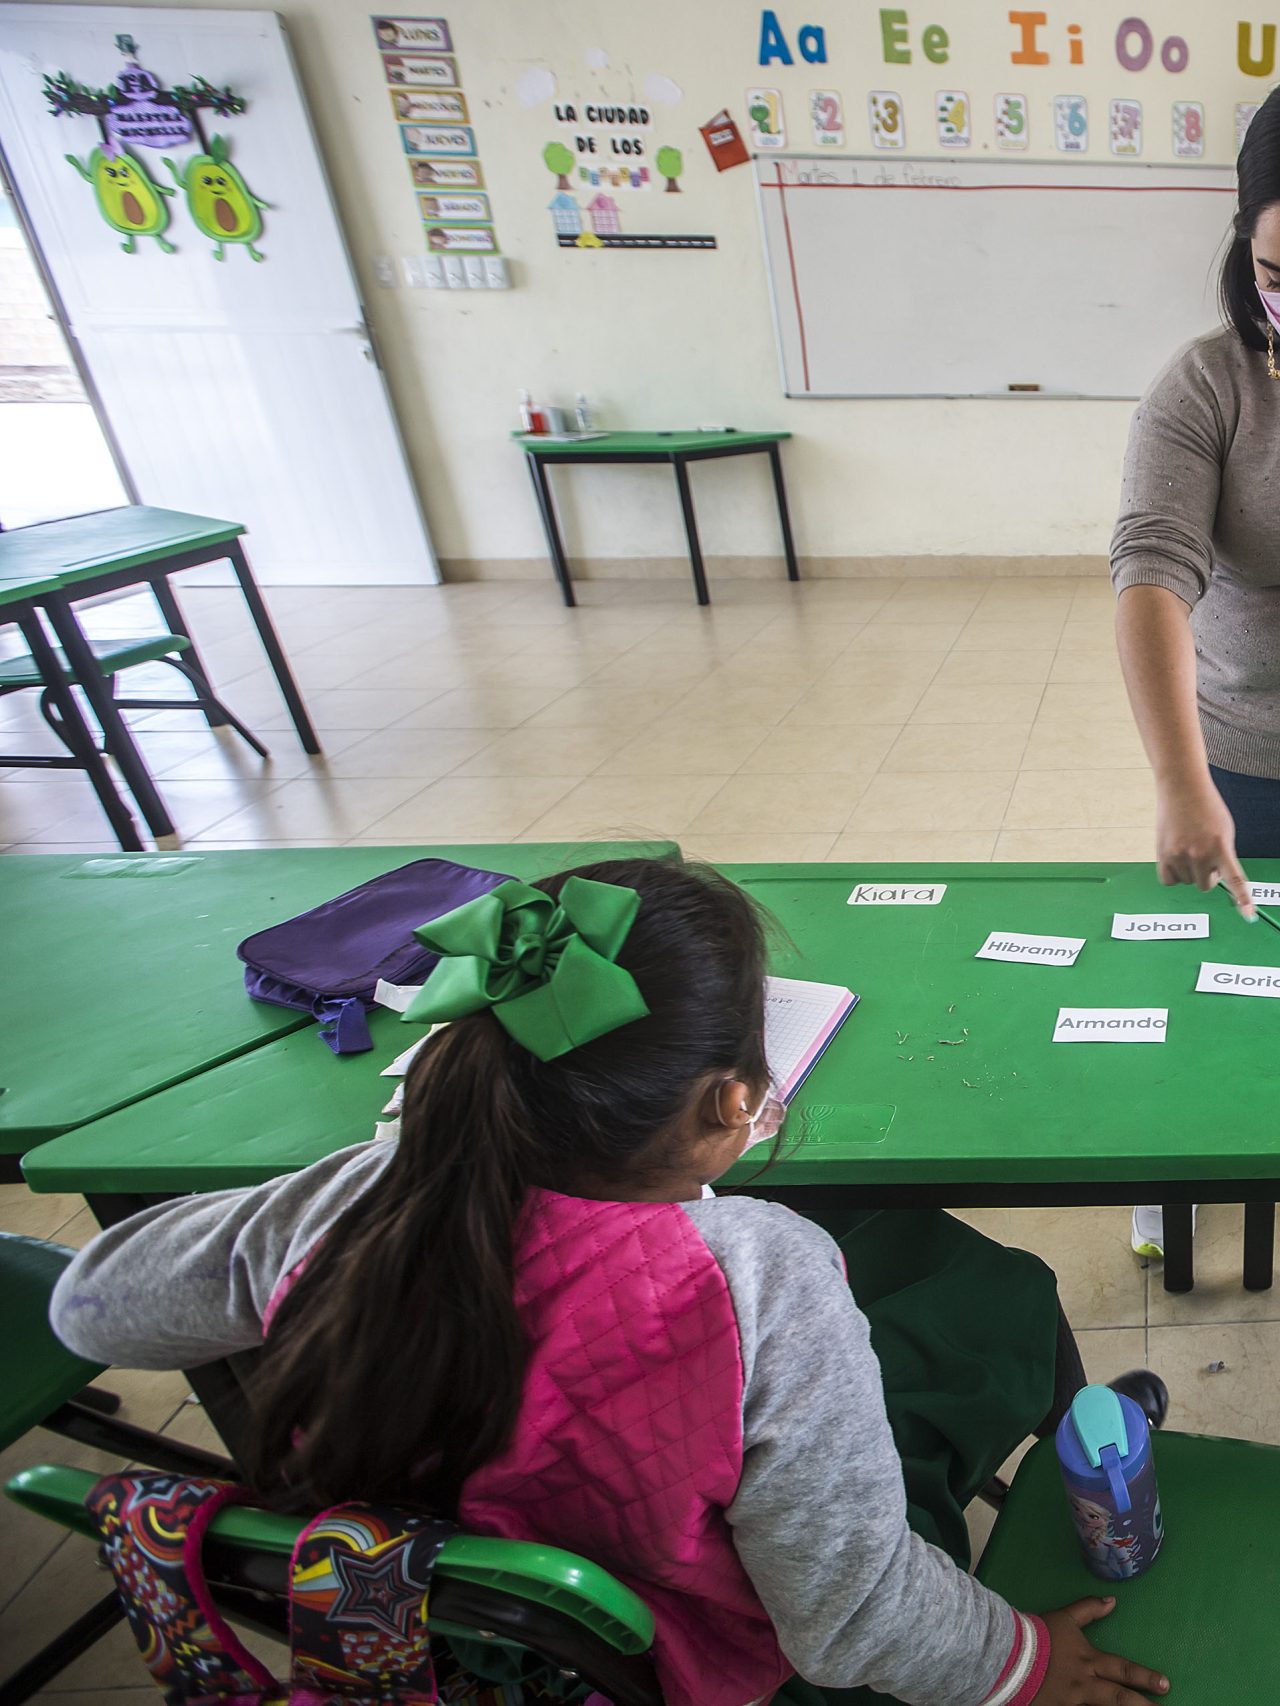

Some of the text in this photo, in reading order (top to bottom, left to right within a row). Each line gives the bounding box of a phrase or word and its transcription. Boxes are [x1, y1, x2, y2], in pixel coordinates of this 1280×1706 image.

[758, 9, 828, 66] Aa
[879, 8, 950, 65] Ee
[1008, 10, 1084, 65] Ii
[1116, 17, 1189, 73] Oo
[115, 112, 184, 122] MAESTRA
[554, 104, 650, 125] LA CIUDAD
[823, 96, 843, 131] 2
[880, 98, 899, 134] 3
[948, 99, 966, 134] 4
[1007, 99, 1024, 135] 5
[1068, 102, 1087, 137] 6
[1184, 108, 1202, 143] 8
[575, 136, 643, 155] DE LOS
[874, 165, 897, 186] de
[853, 886, 936, 903] Kiara
[1124, 920, 1197, 933] Johan
[988, 940, 1080, 960] Hibranny
[1058, 1016, 1167, 1030] Armando
